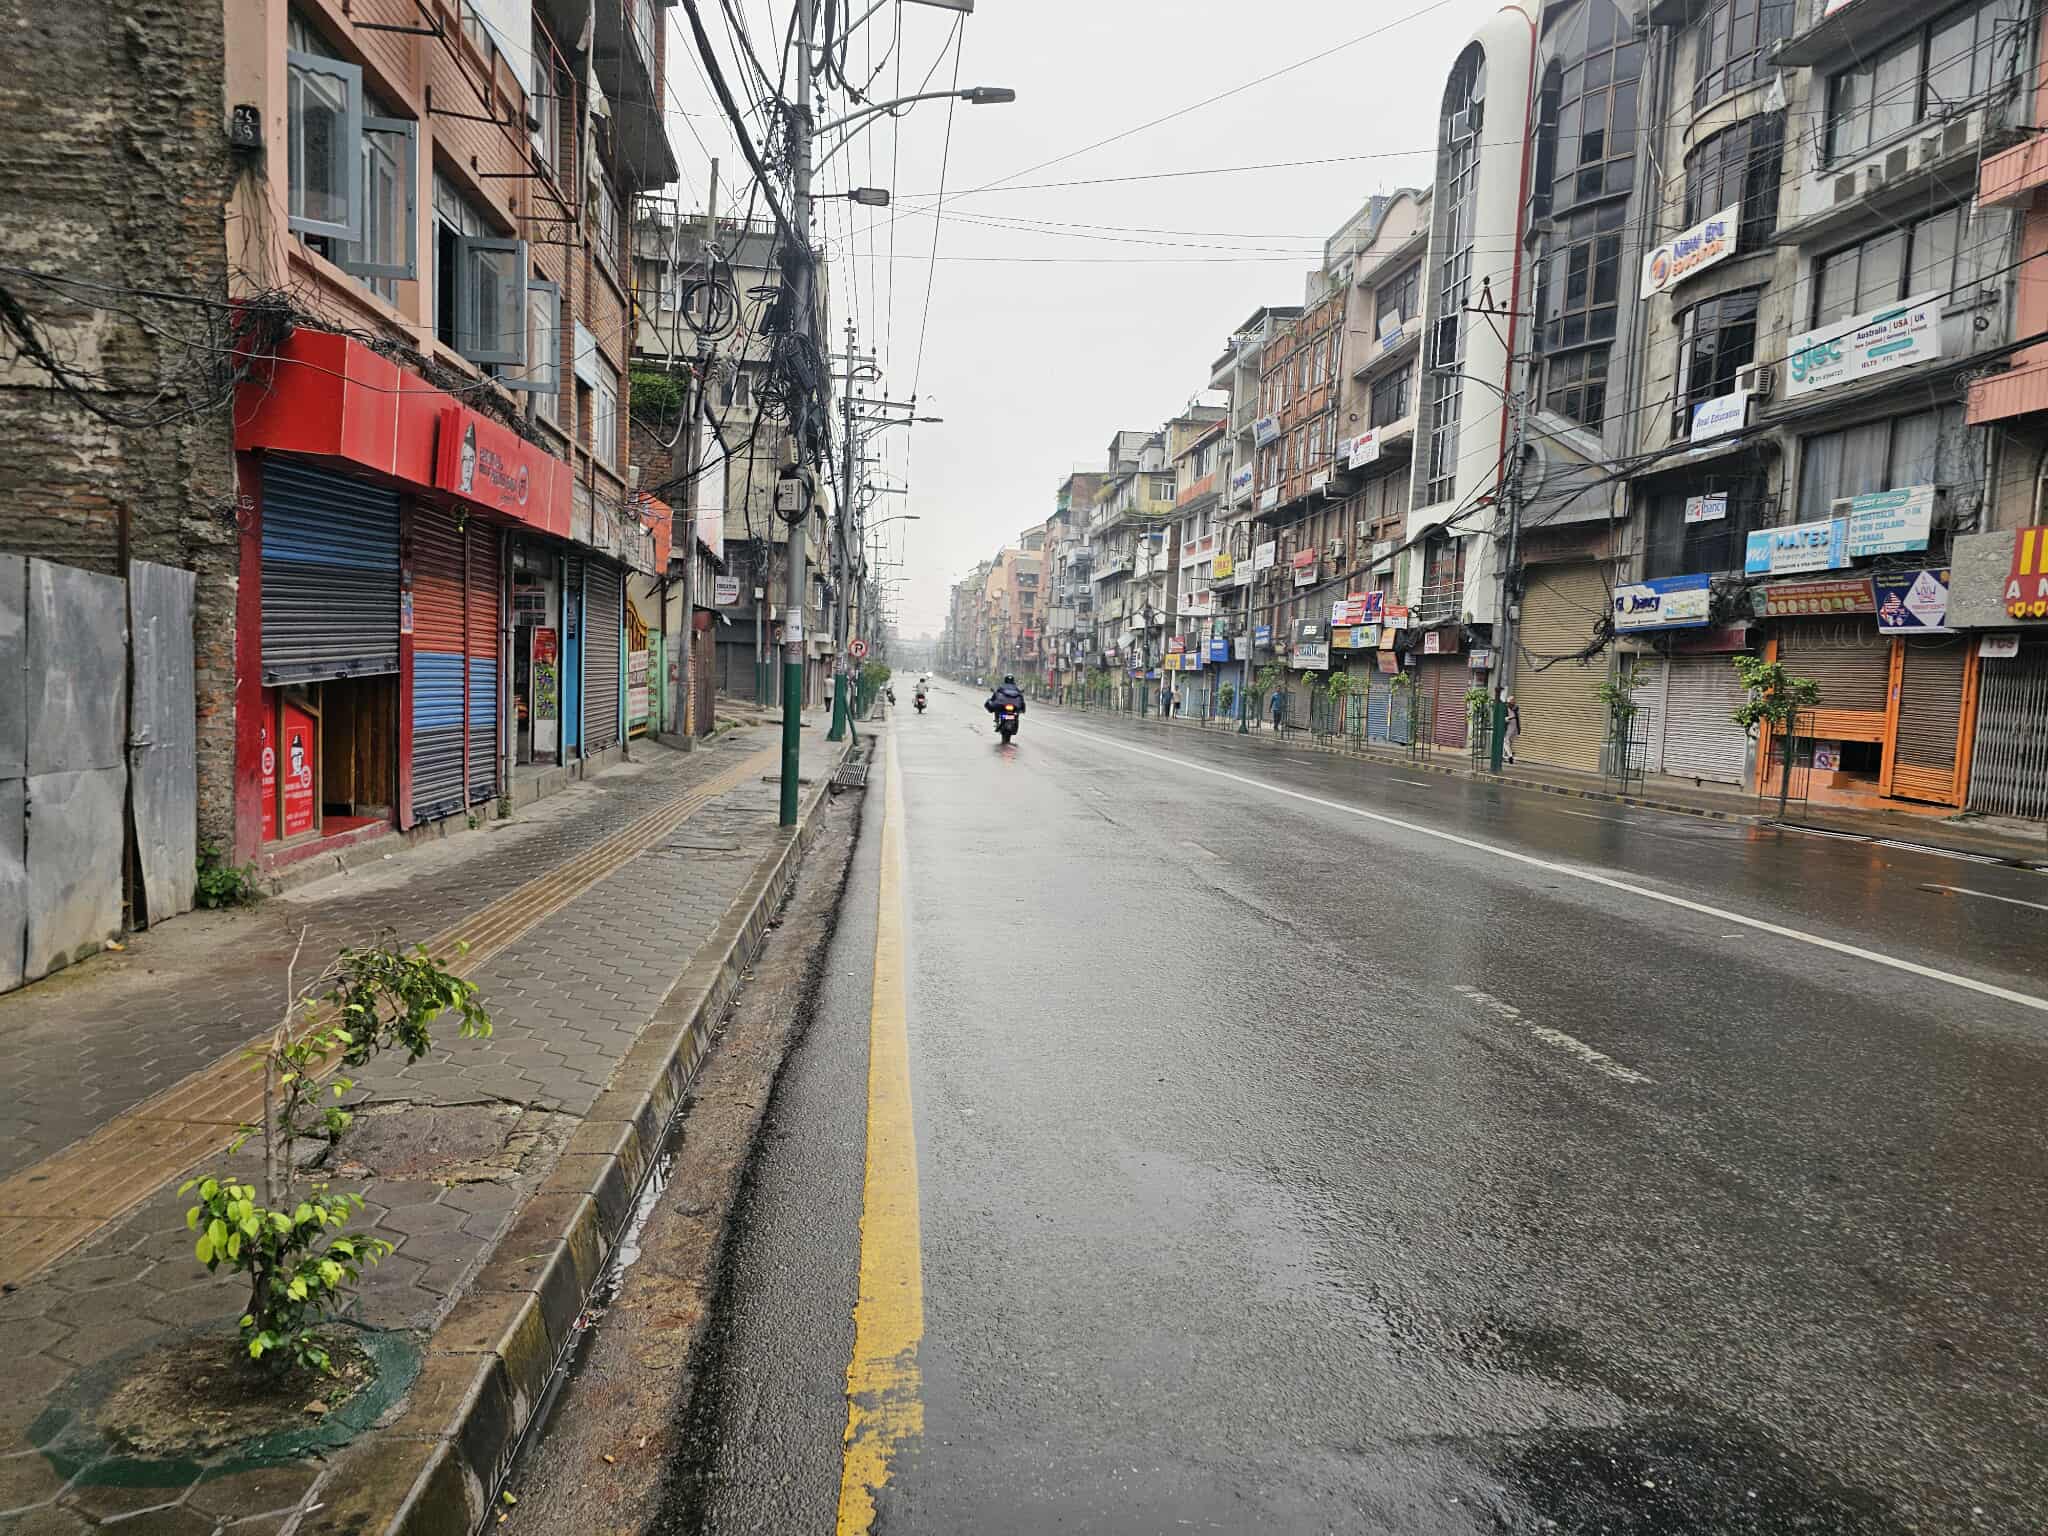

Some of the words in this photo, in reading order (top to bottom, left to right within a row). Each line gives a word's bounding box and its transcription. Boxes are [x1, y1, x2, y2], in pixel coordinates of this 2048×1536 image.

[1857, 325, 1887, 341] Australia
[1893, 319, 1908, 329] USA
[1914, 312, 1926, 322] UK
[1792, 336, 1841, 382] giec
[1776, 528, 1830, 550] MATES
